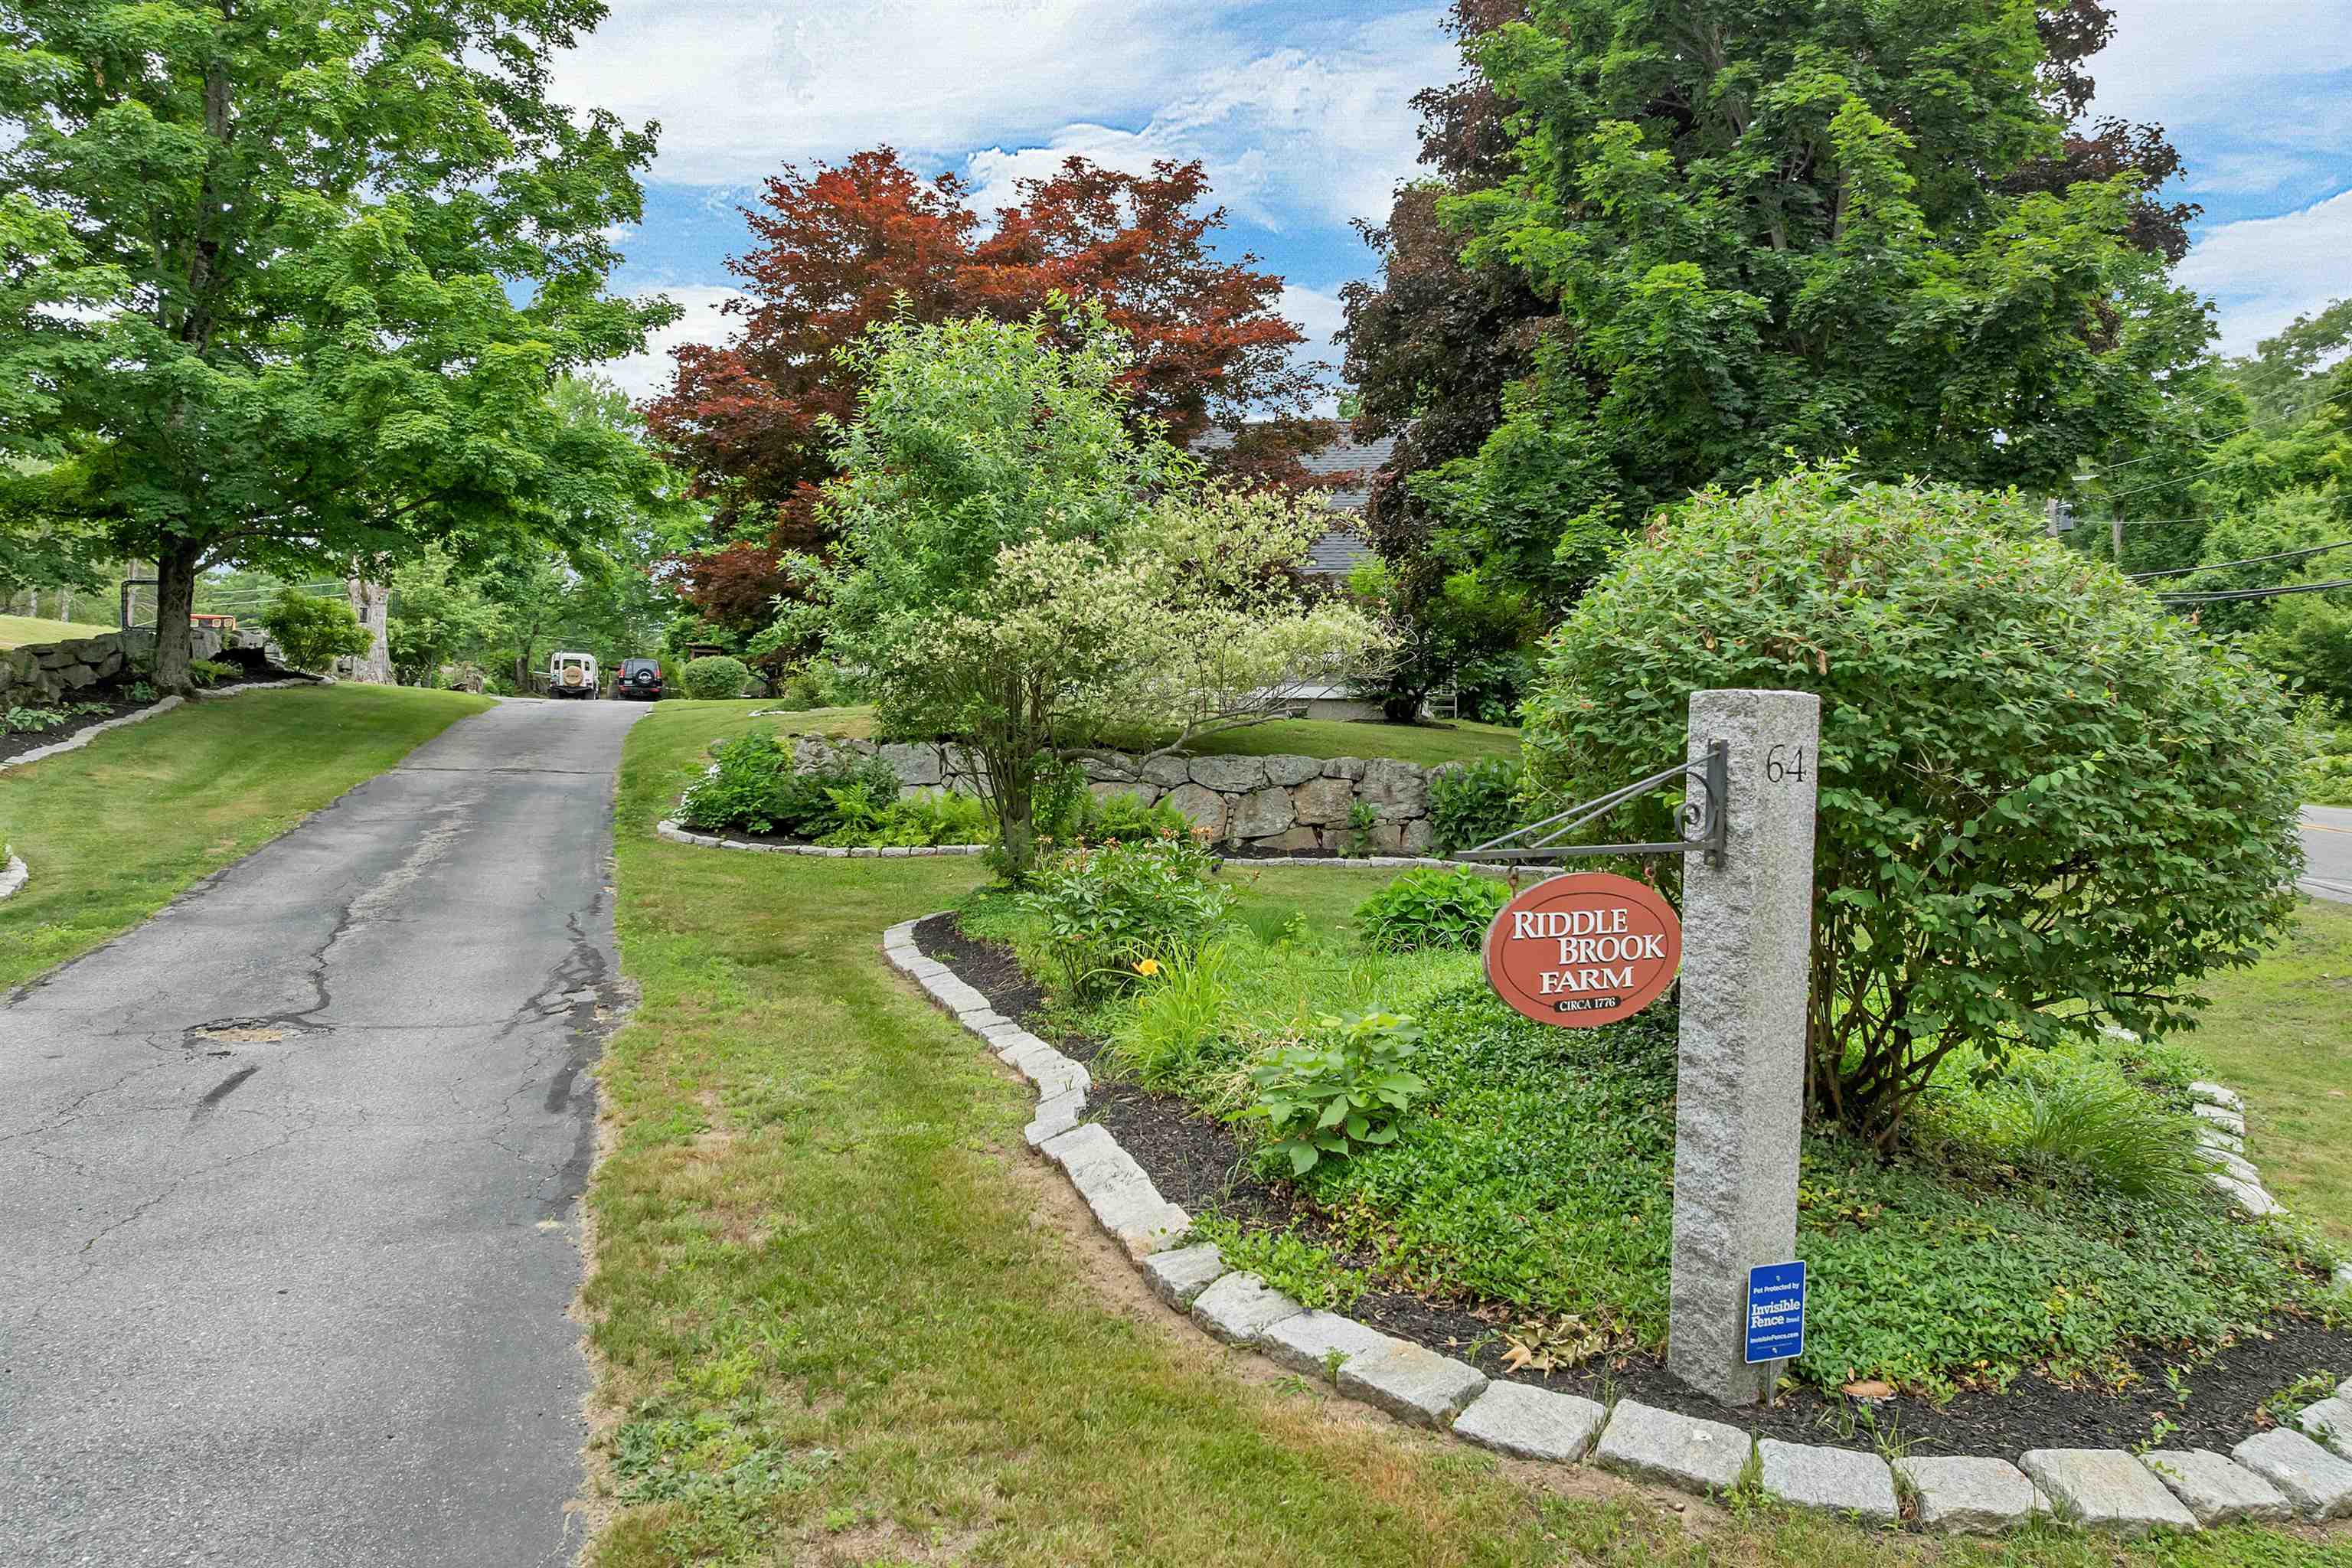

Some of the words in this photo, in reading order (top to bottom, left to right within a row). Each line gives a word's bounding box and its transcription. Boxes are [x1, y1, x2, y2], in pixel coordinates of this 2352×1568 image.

[1767, 744, 1807, 782] 64
[1512, 909, 1628, 939] RIDDLE
[1557, 934, 1665, 965] BROOK
[1539, 966, 1635, 994] FARM
[1559, 998, 1591, 1011] CIRCA
[1594, 997, 1616, 1008] 1776
[1764, 1283, 1791, 1293] Protected
[1751, 1299, 1801, 1315] Invisible
[1751, 1316, 1785, 1328] Fence
[1750, 1332, 1799, 1343] IibleFence.com
